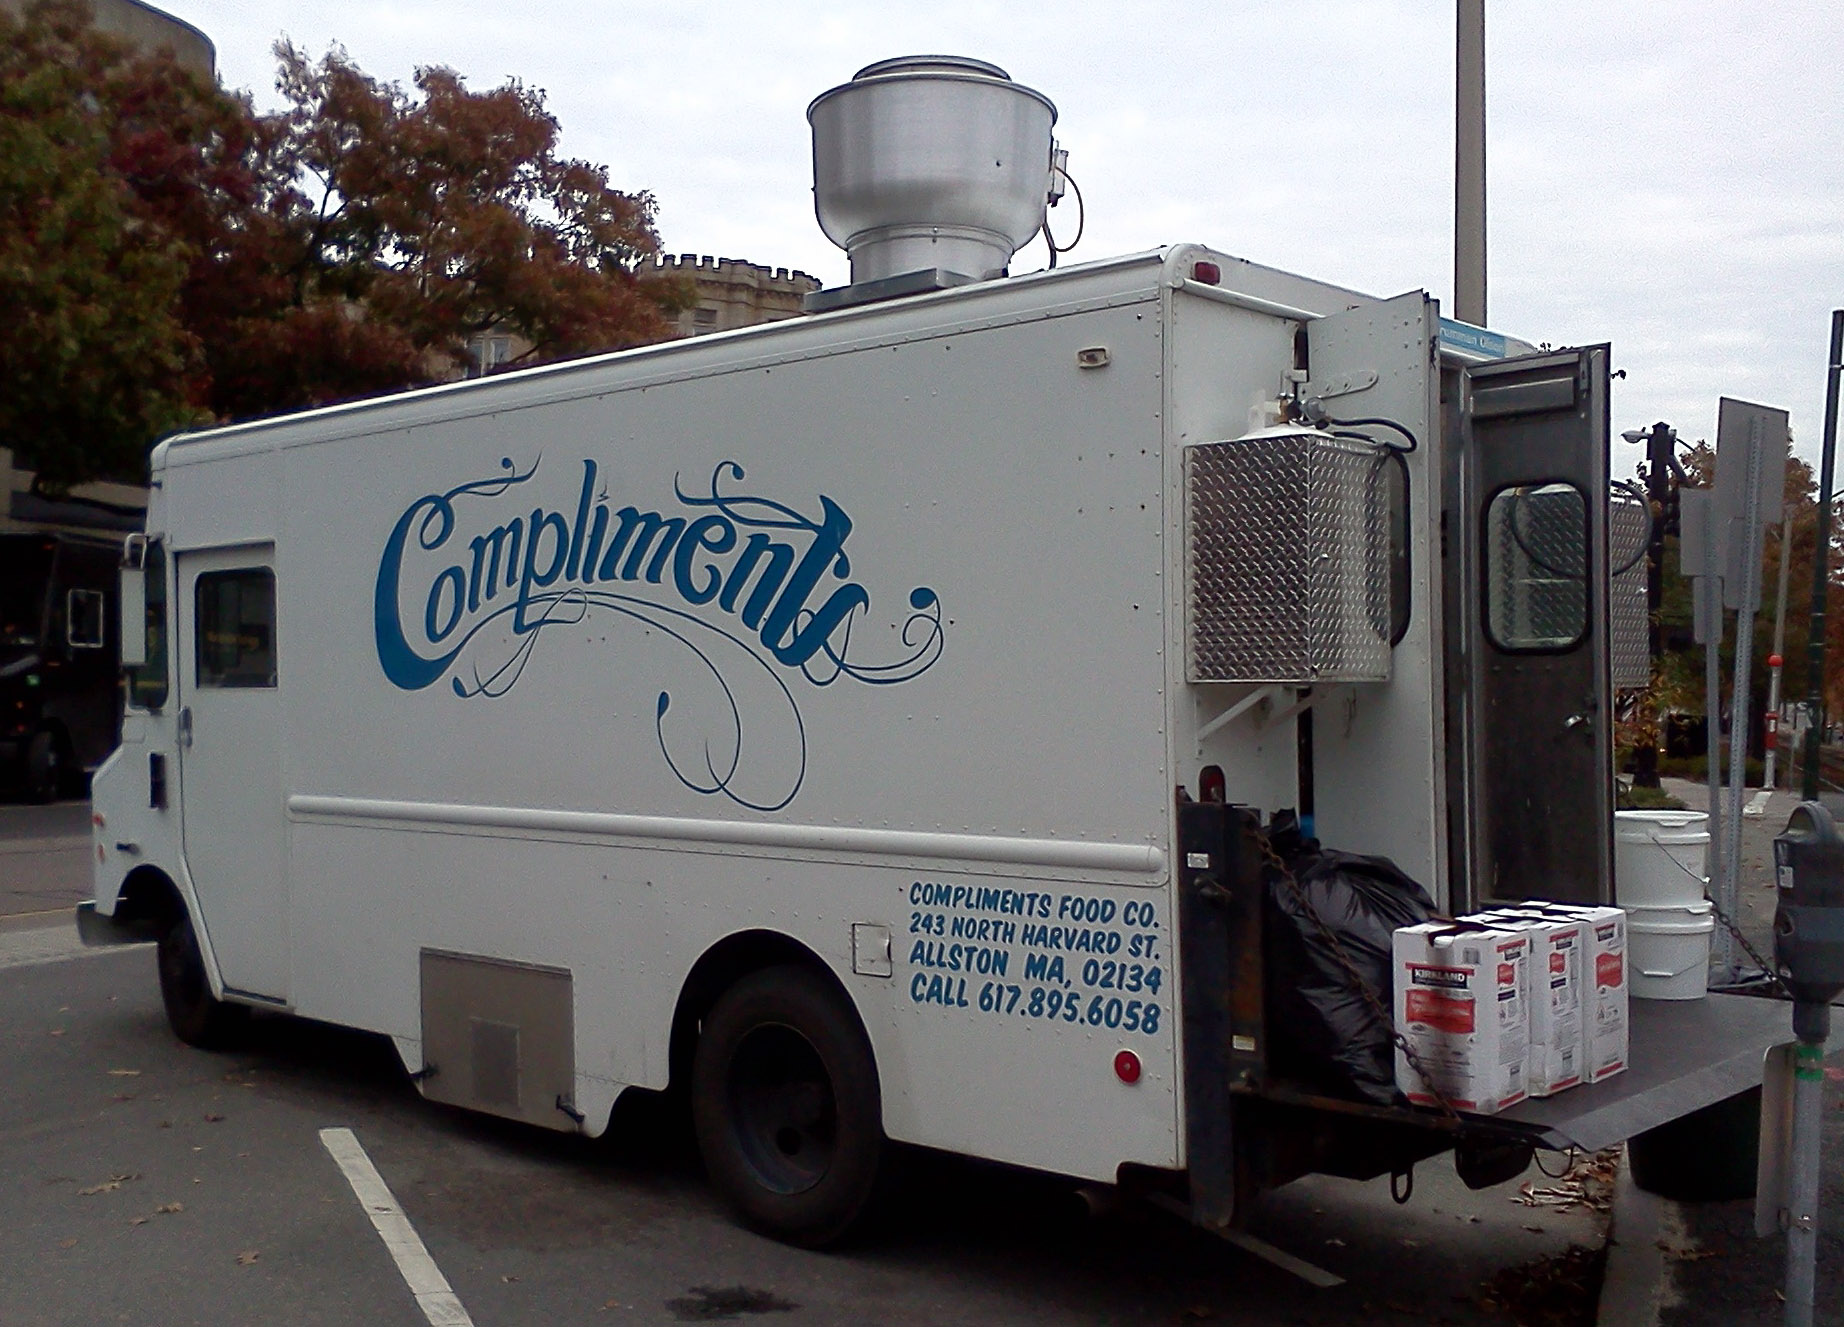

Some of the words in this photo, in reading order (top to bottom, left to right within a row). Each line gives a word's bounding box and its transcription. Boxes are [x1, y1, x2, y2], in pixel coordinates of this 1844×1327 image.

[375, 453, 872, 698] Compliments
[909, 881, 1052, 918] COMPLIMENTS
[1058, 895, 1117, 923] FOOD
[1123, 901, 1160, 929] CO.
[909, 912, 945, 936] 243
[951, 917, 1015, 944] NORTH
[1021, 924, 1122, 955] HARVARD
[1128, 934, 1160, 960] ST.
[909, 939, 1008, 976] ALLSTON
[1024, 953, 1072, 989] MA,
[1082, 958, 1163, 995] 02134
[1414, 968, 1466, 982] KIRKLAND
[910, 972, 969, 1008] CALL
[978, 981, 1161, 1035] 617.895.6058
